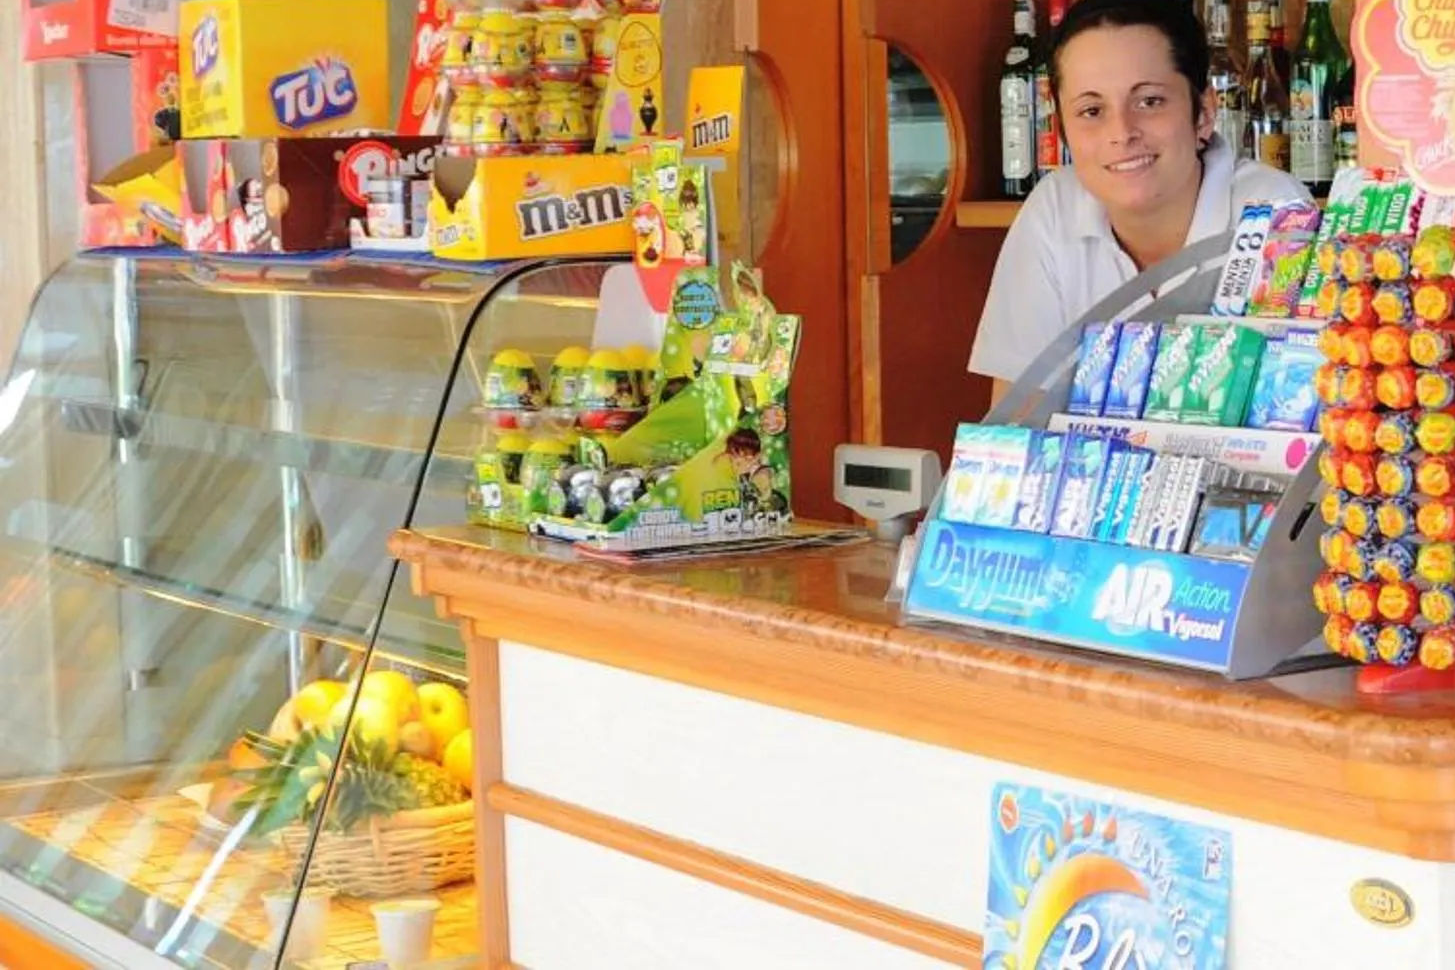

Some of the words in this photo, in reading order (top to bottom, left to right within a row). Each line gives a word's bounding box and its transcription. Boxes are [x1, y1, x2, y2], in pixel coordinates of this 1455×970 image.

[193, 15, 218, 76] TUC
[273, 66, 356, 122] TUC
[924, 526, 1047, 611] Daygum
[1092, 562, 1173, 630] AIR
[1174, 580, 1230, 612] Action
[1164, 611, 1226, 642] Vigorsol
